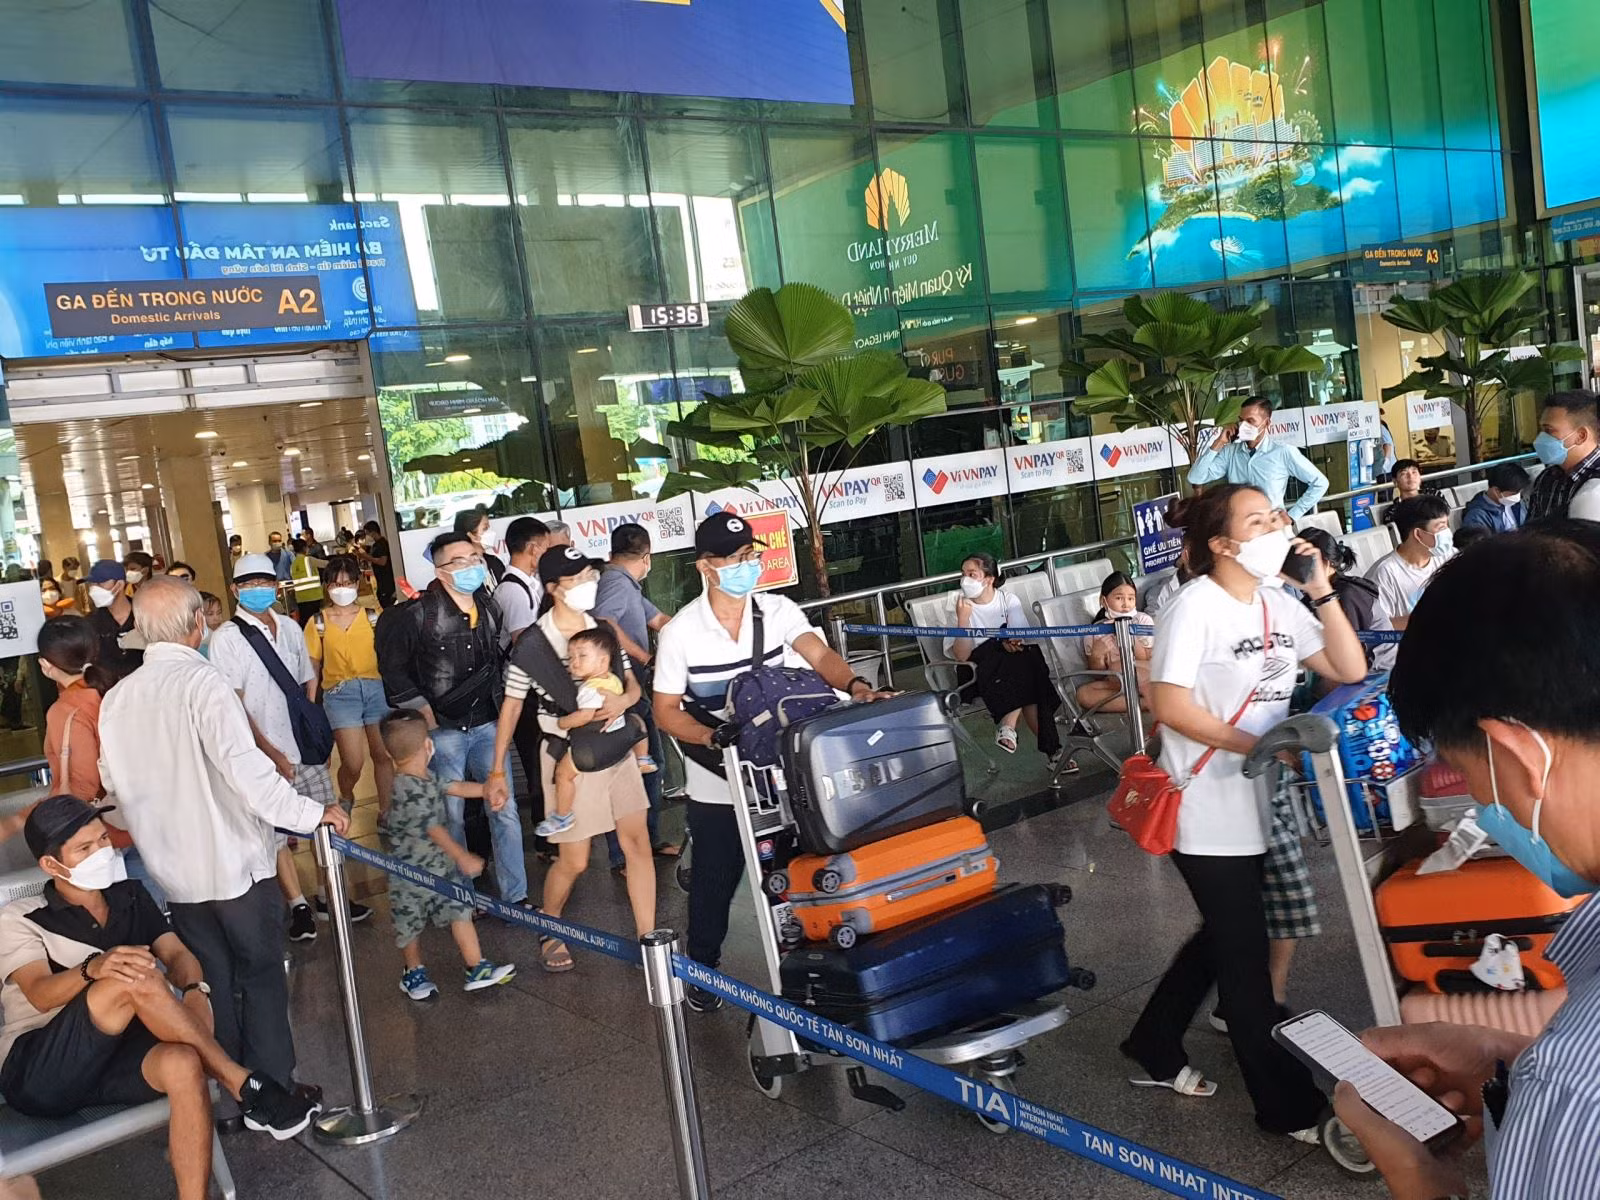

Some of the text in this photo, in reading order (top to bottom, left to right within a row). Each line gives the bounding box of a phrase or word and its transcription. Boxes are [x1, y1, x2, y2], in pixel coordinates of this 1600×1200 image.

[1426, 249, 1439, 264] A3
[55, 286, 264, 311] GA ĐẾN TRONG NƯỚC
[277, 288, 318, 314] A2
[111, 309, 221, 325] Domestic Arrivals
[651, 305, 698, 325] 15:36
[1275, 421, 1300, 434] VNPAY
[1310, 412, 1340, 427] VNPAY
[1133, 441, 1163, 455] VNPAY
[1013, 452, 1056, 471] VNPAY
[962, 465, 998, 481] VNPAY
[754, 495, 798, 512] VNPAY
[828, 501, 845, 509] Scan
[588, 538, 609, 548] Scan
[767, 556, 791, 571] AREA
[1145, 556, 1168, 568] PRIORITY
[964, 628, 984, 637] TIA
[1380, 633, 1395, 641] TAN
[452, 884, 475, 906] TIA
[499, 904, 511, 917] TAN
[511, 907, 524, 920] SON
[539, 916, 590, 944] INTERNATIONAL
[687, 962, 712, 985] CẢNG
[713, 974, 739, 996] HÀNG
[739, 987, 774, 1013] KHÔNG
[775, 1003, 804, 1027] QUỐC
[806, 1015, 820, 1034] TẾ
[821, 1021, 844, 1045] TÂN
[846, 1031, 871, 1054] SƠN
[953, 1076, 1012, 1121] TIA
[1019, 1109, 1070, 1137] INTERNATIONAL
[1019, 1120, 1048, 1138] AIRPORT
[1081, 1130, 1114, 1159] TAN
[1118, 1147, 1155, 1175] SON
[1159, 1161, 1208, 1195] NHAT
